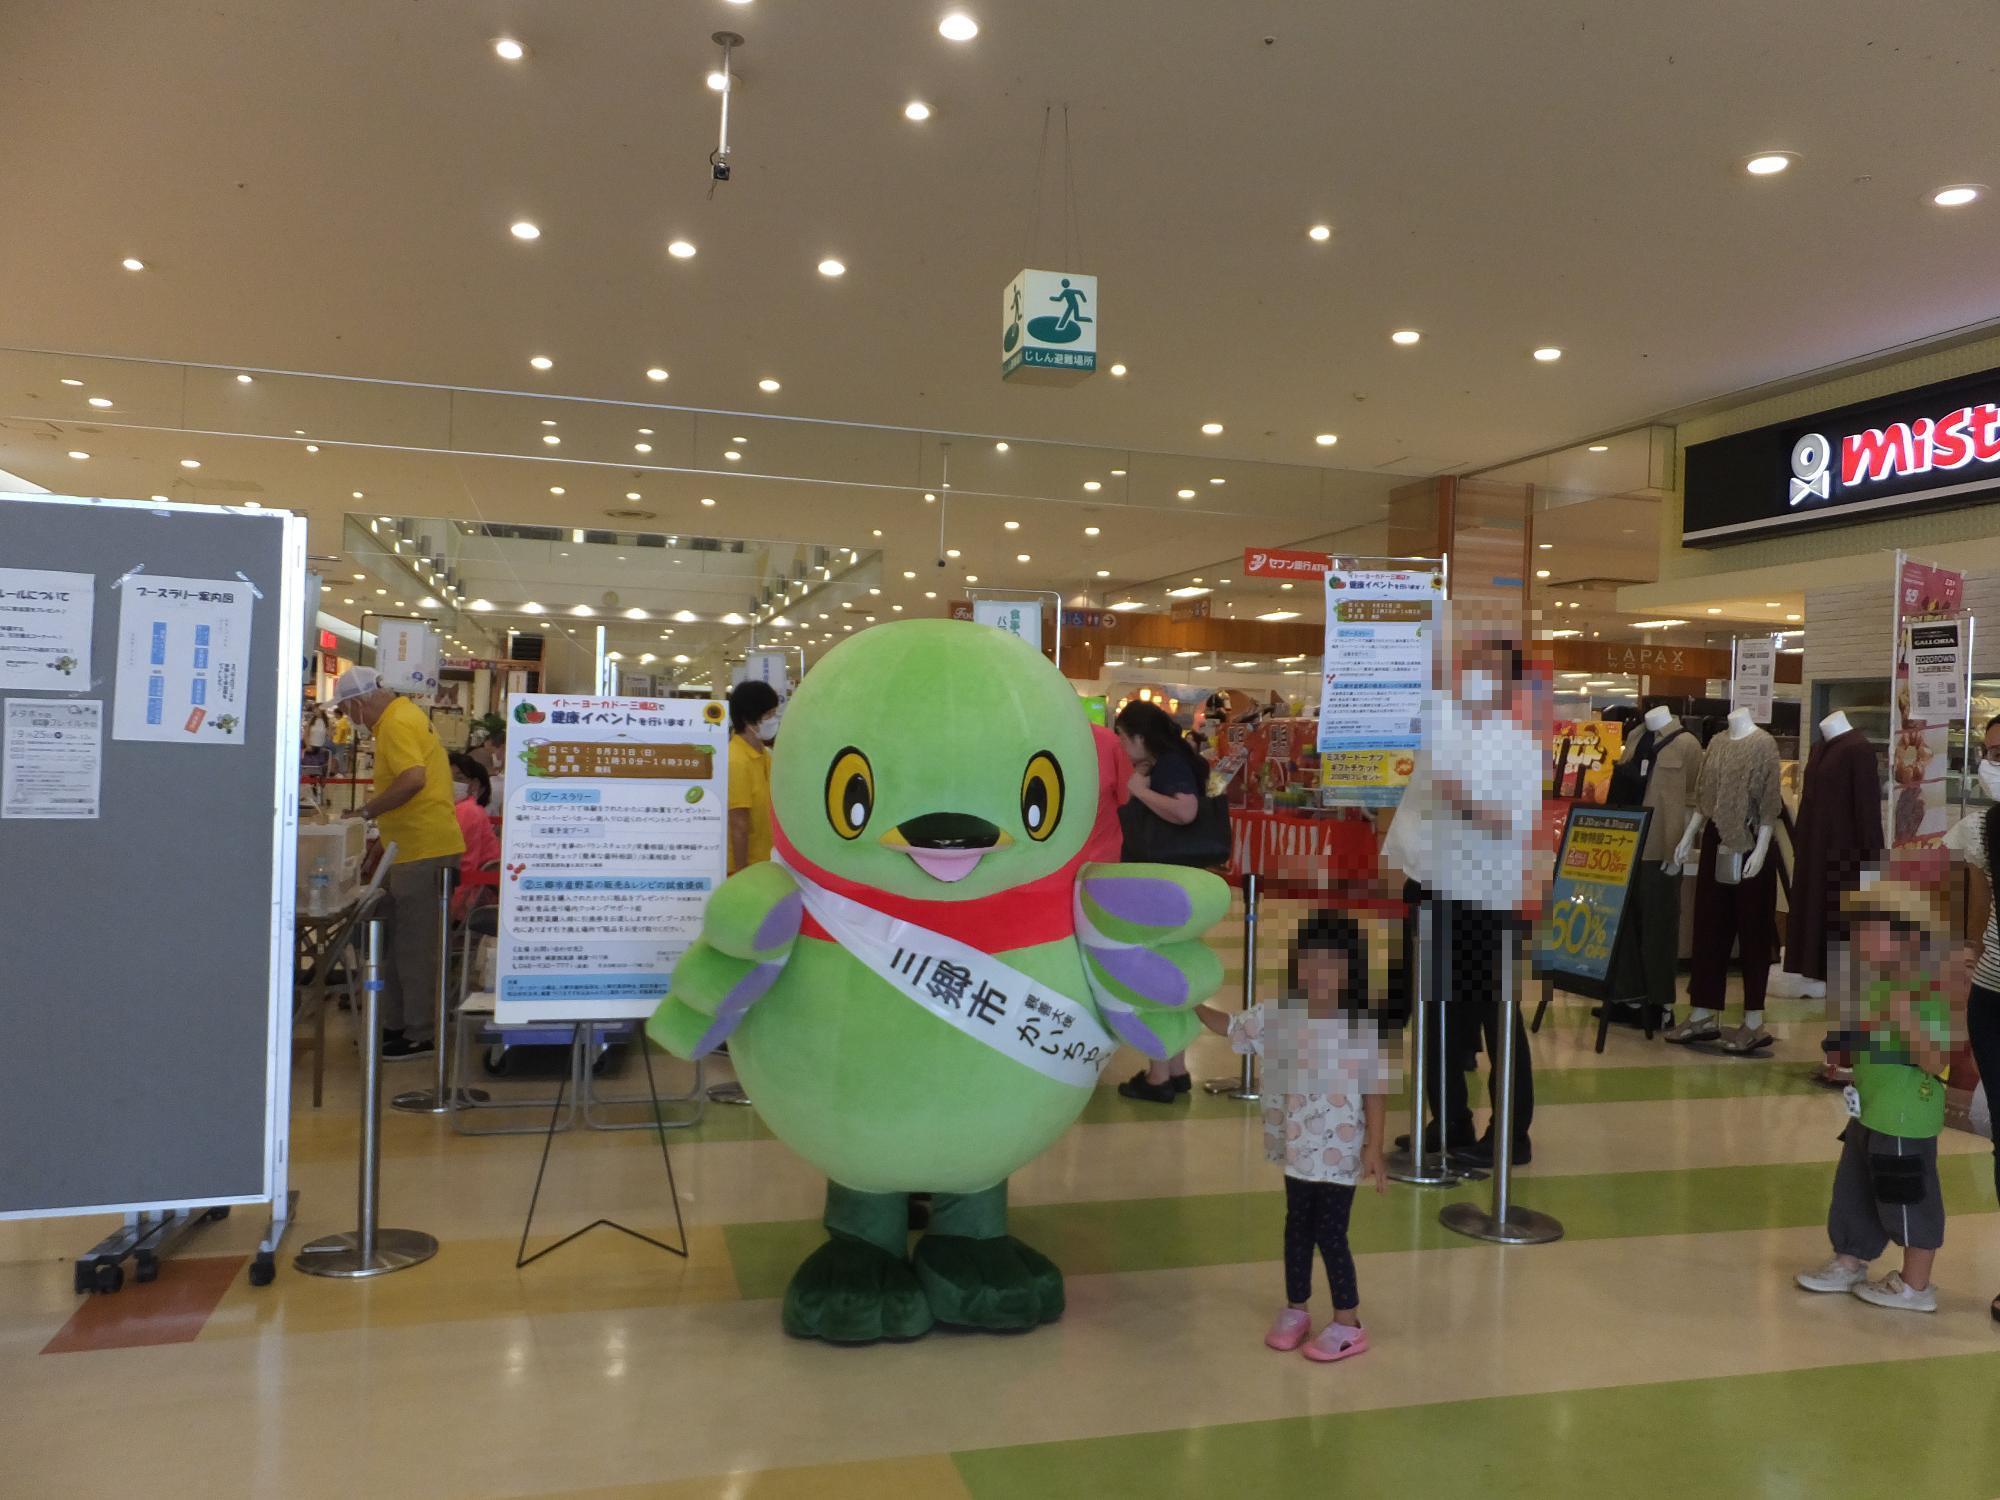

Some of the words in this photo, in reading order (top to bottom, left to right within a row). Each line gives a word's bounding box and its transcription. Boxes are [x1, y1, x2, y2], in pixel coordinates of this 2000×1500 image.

[1025, 351, 1094, 366] じしん避難場所
[1607, 647, 1684, 664] LAPAX
[551, 710, 693, 727] 健康イベントを行います！
[890, 947, 1008, 1026] 三郷市
[1024, 993, 1076, 1029] 親善大使
